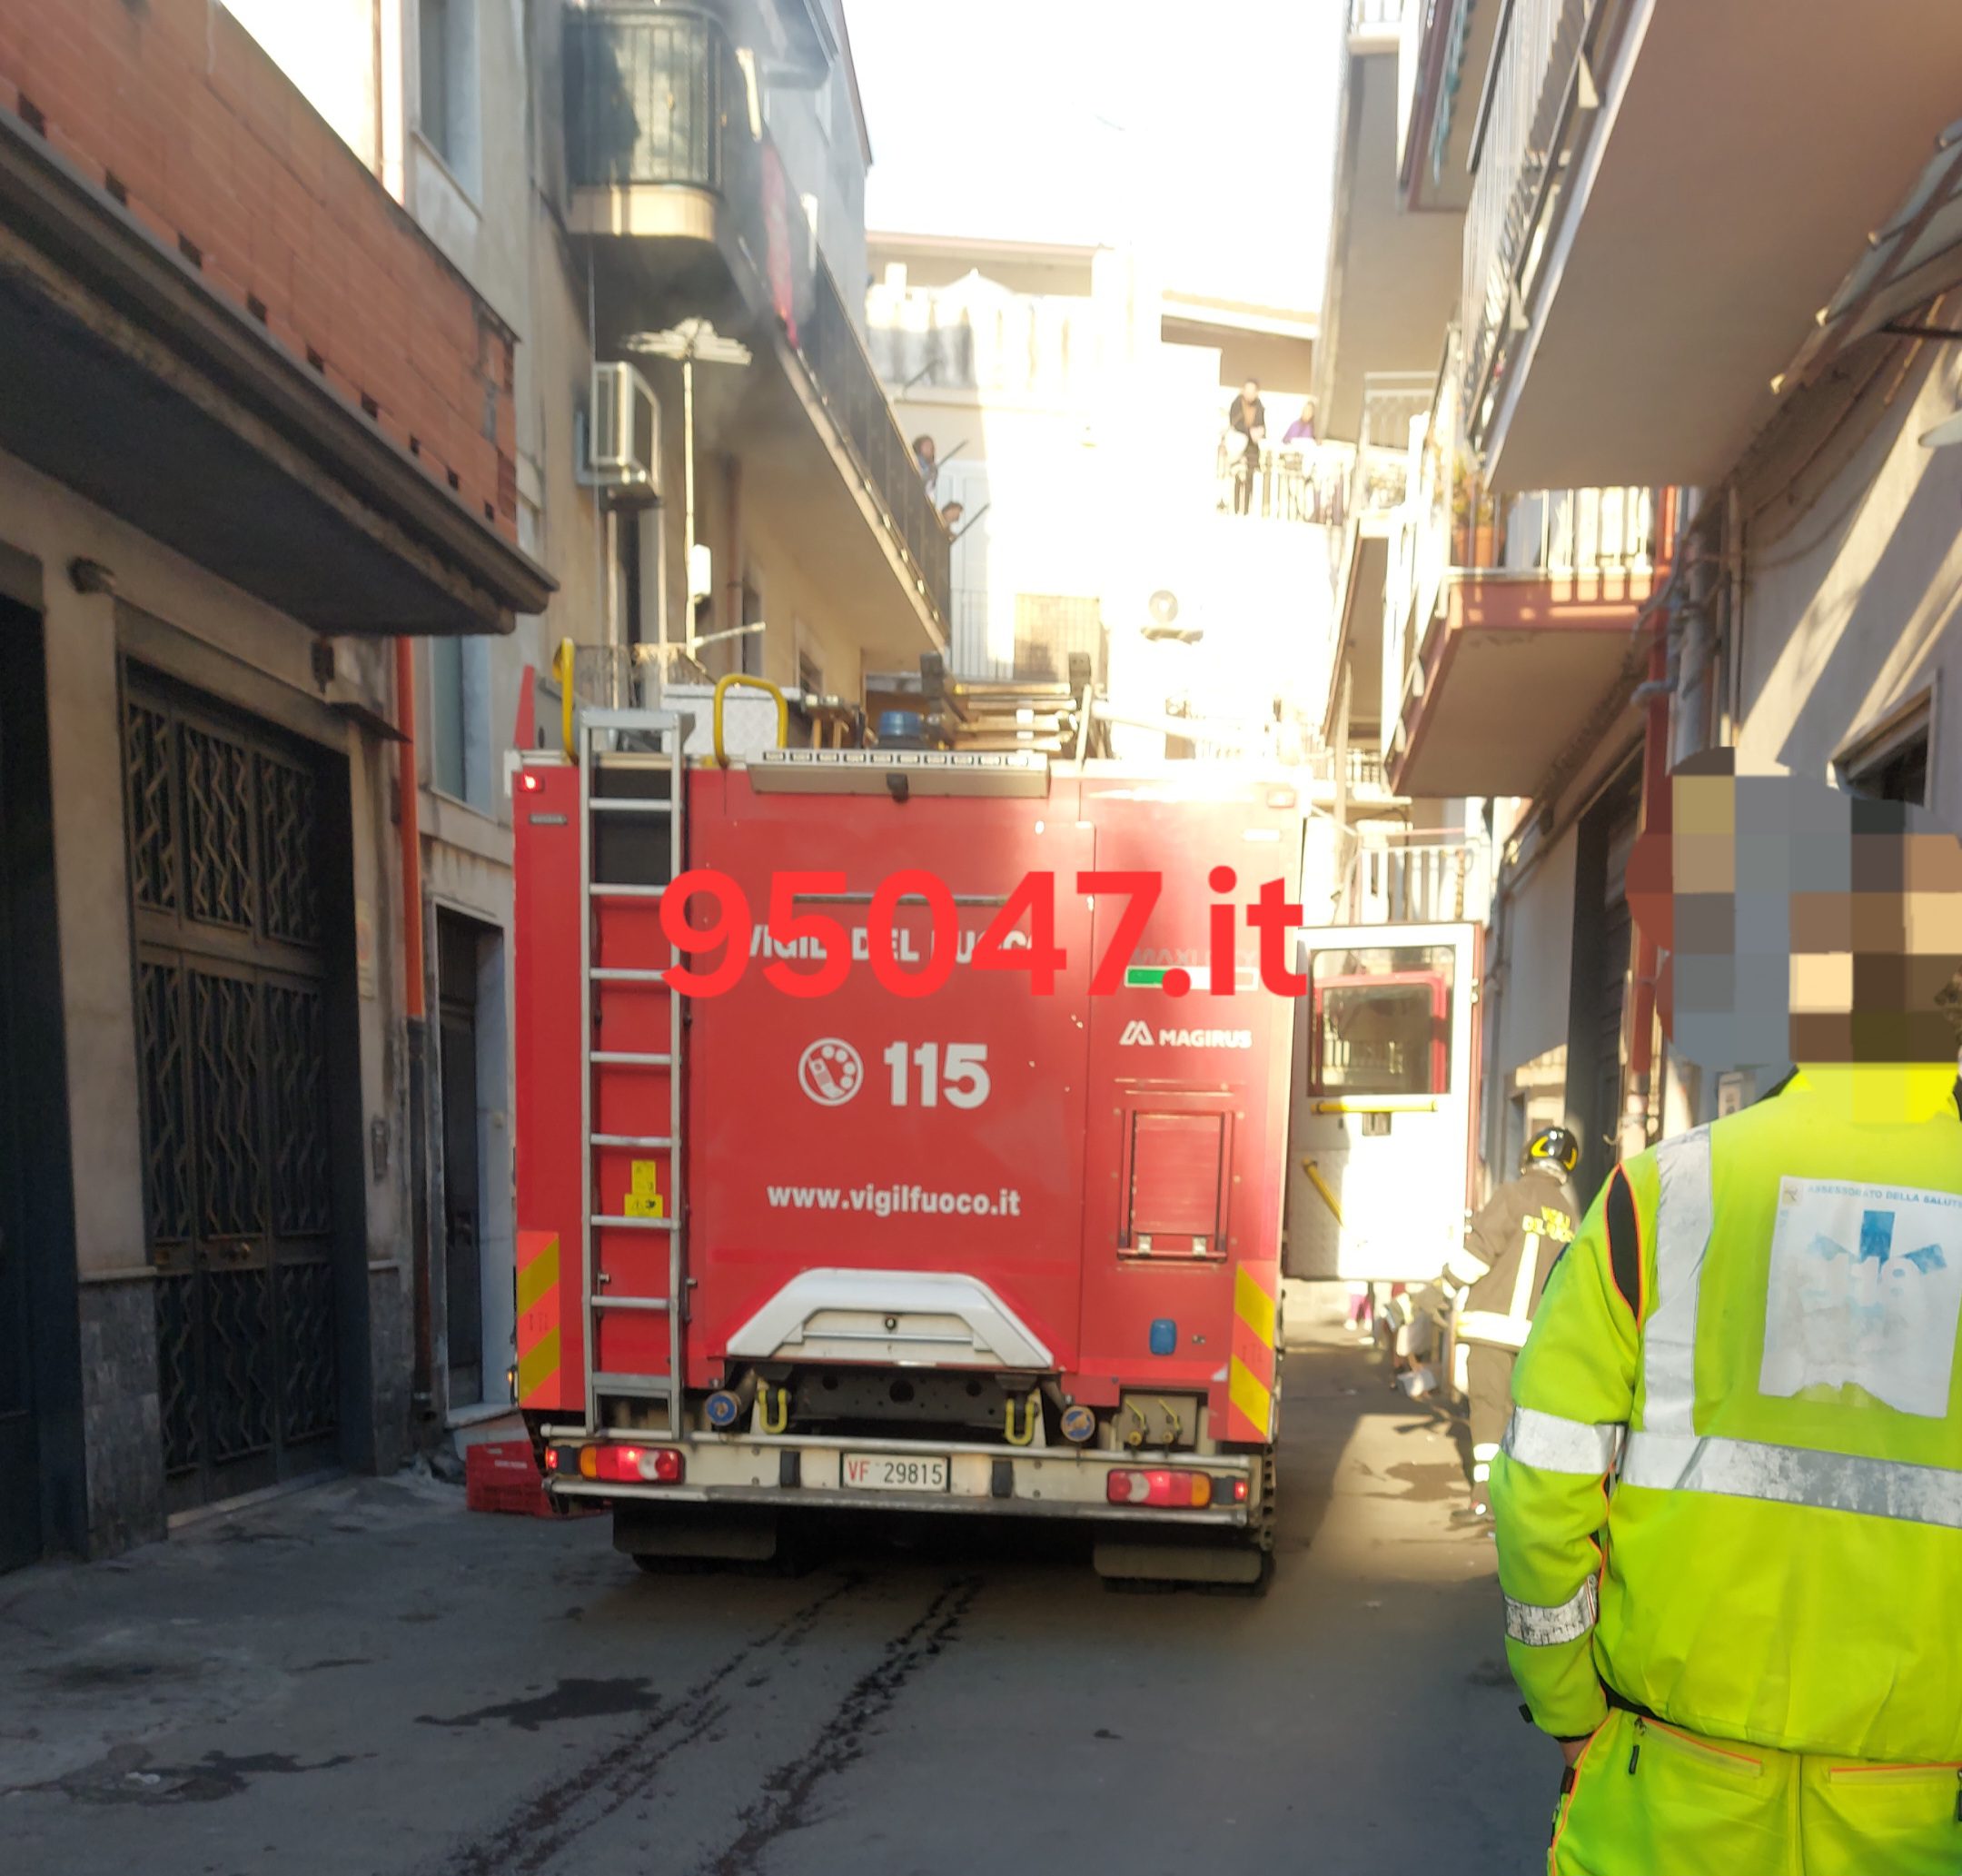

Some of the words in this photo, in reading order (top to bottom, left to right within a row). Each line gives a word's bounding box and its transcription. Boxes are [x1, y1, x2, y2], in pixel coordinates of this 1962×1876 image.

[1159, 1028, 1253, 1048] MAGIRUS
[884, 1042, 990, 1109] 115
[767, 1185, 1021, 1217] www.vigilfuoco.it
[1886, 1188, 1919, 1203] DELLA
[847, 1460, 870, 1484] VF
[884, 1461, 943, 1485] 29815
